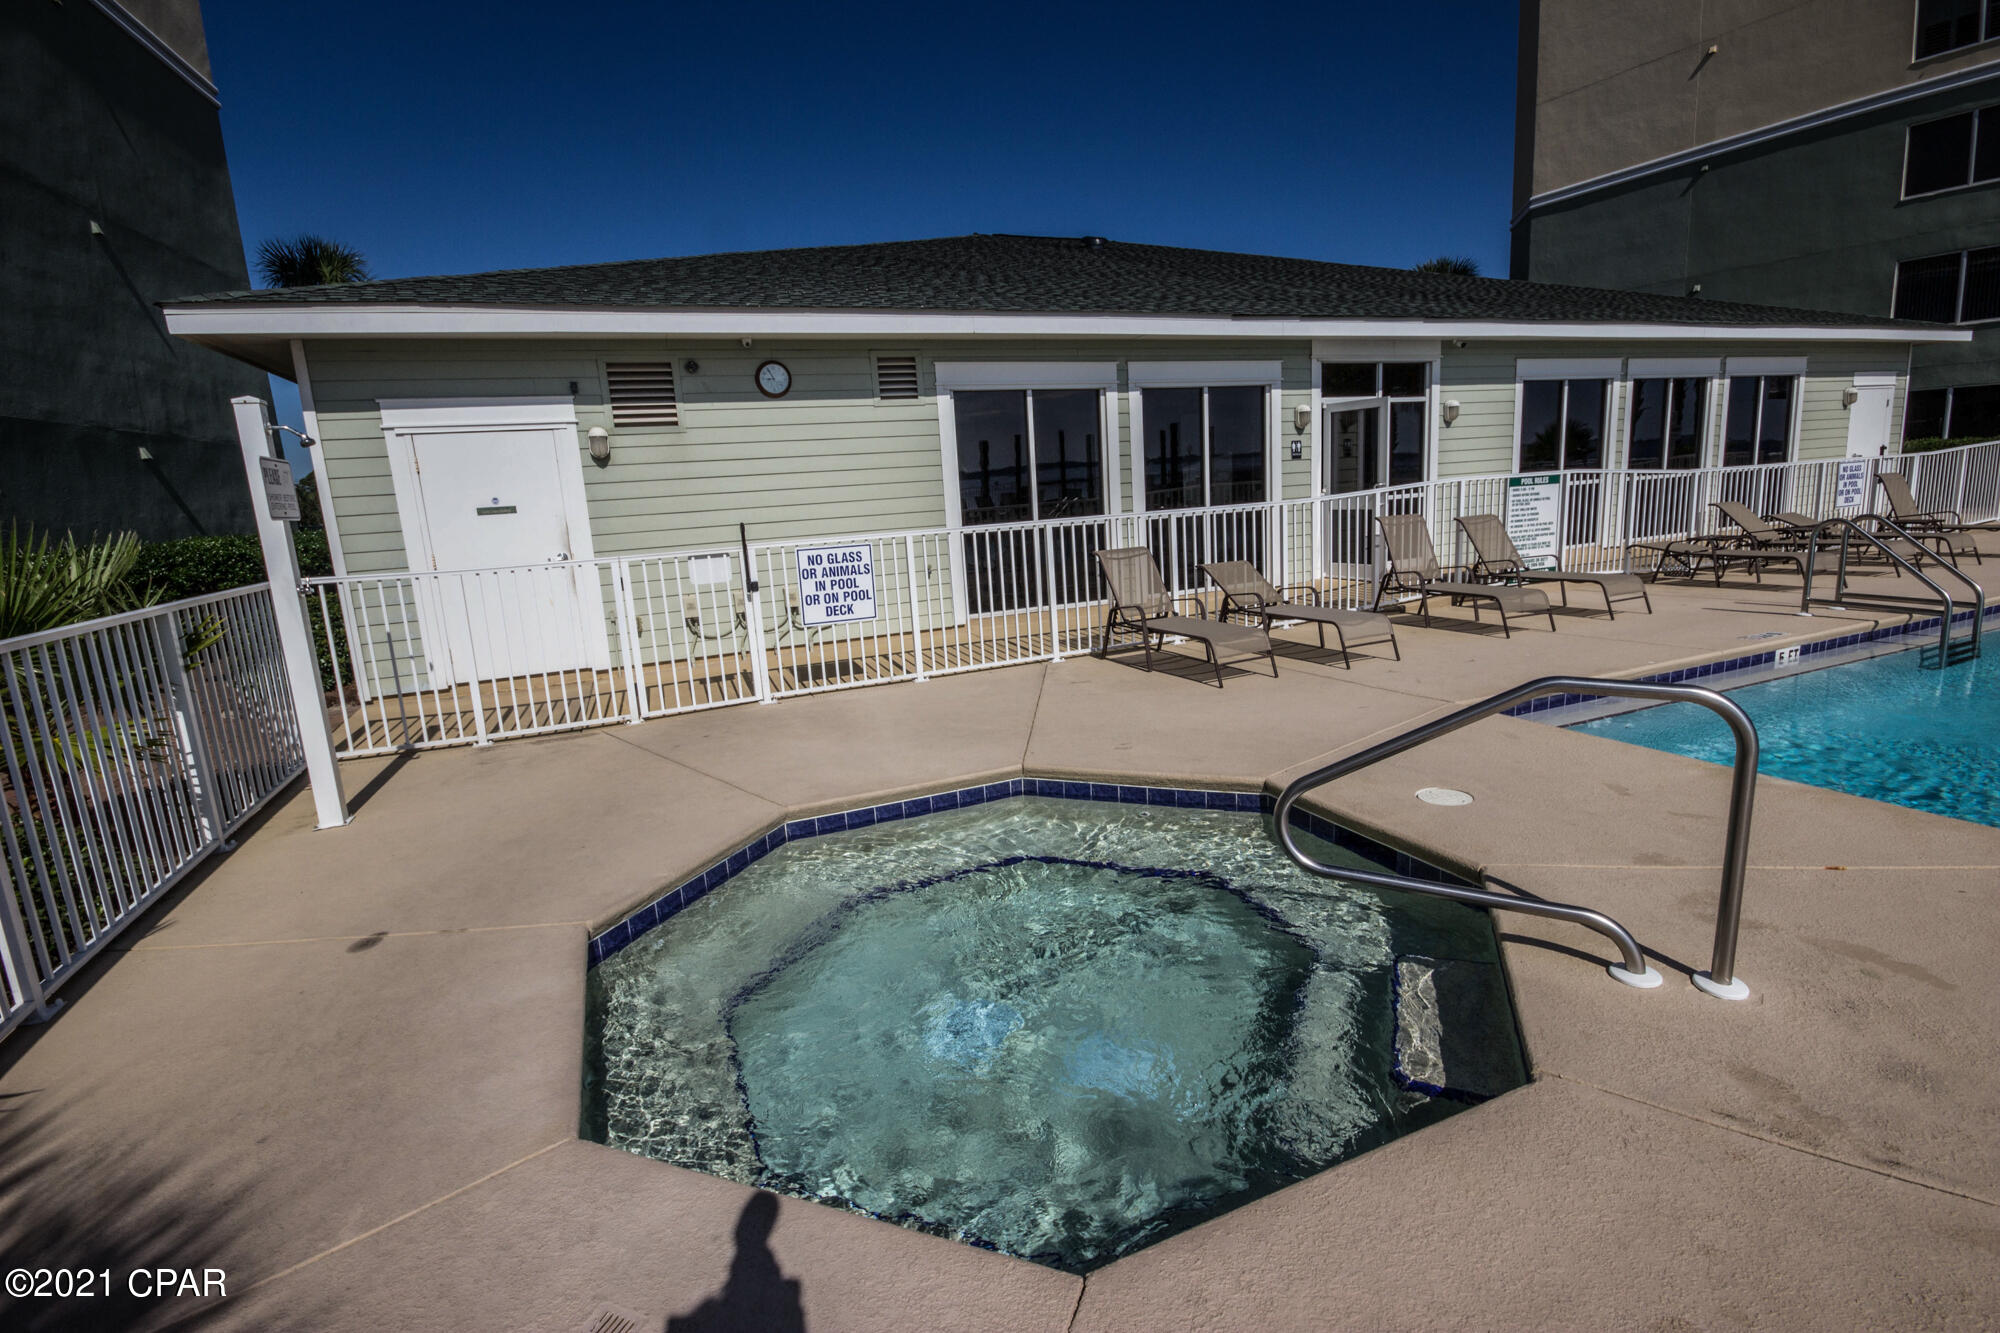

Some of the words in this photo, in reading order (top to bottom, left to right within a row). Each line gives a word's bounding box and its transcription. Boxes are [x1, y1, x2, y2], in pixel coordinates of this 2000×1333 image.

[1534, 476, 1549, 484] RULES
[807, 554, 823, 567] NO
[827, 551, 863, 565] GLASS
[801, 568, 817, 580] OR
[822, 563, 870, 579] ANIMALS
[815, 580, 826, 592] IN
[831, 578, 860, 591] POOL
[805, 594, 821, 606] OR
[824, 592, 839, 605] ON
[843, 589, 872, 603] POOL
[826, 603, 855, 617] DECK
